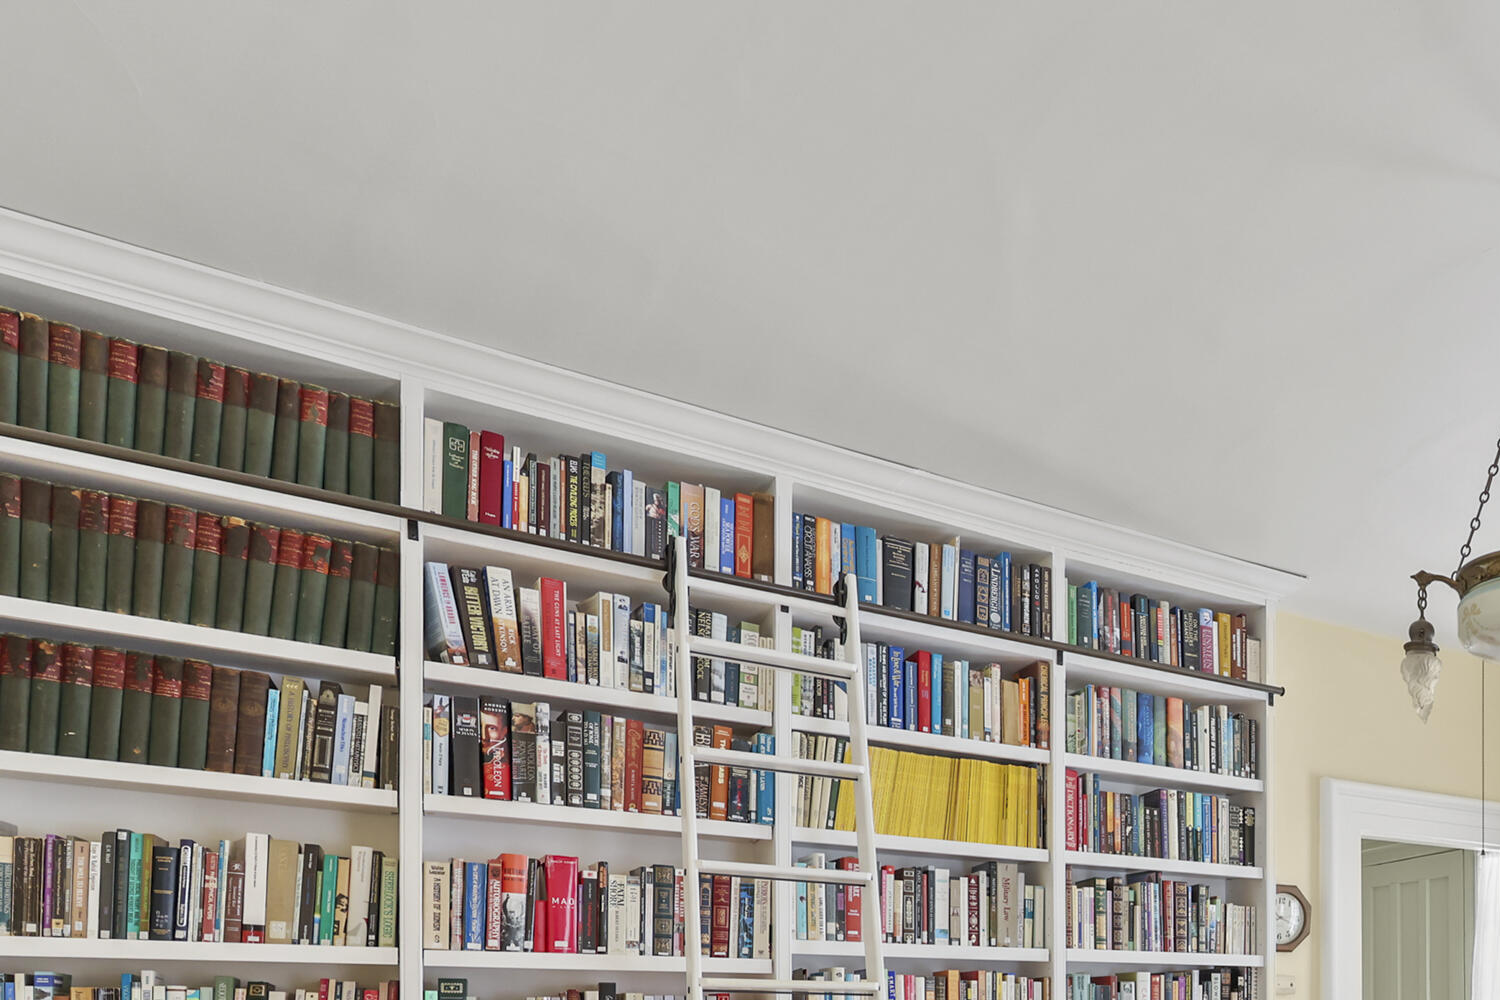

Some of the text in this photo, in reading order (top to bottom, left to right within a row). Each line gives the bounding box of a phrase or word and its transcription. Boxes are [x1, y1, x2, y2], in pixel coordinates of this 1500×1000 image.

[690, 538, 702, 558] WAR
[490, 577, 502, 614] AT DAWN
[502, 579, 514, 616] AN ARMY
[990, 568, 1000, 612] LINDBERGH
[464, 586, 488, 652] BITTER VICTORY
[554, 618, 561, 626] AT
[1182, 621, 1190, 643] GIANTS
[1186, 612, 1194, 646] SHOULDERS
[1191, 618, 1198, 628] ON
[507, 628, 516, 644] RICK
[287, 697, 295, 722] HISTORY
[1040, 666, 1048, 728] CHEMICAL PRINCIPLES
[282, 732, 292, 768] PHILOSOPHY
[488, 738, 506, 788] NAPOLEON
[1066, 789, 1076, 843] DICTIONARY
[432, 883, 440, 903] HISTORY
[551, 896, 574, 904] MAO
[609, 880, 617, 908] SHORE
[616, 884, 624, 908] FATAL
[1002, 878, 1011, 922] Military Law
[432, 912, 440, 932] ZIONISM
[491, 880, 499, 939] AUTOBIOGRAPHY
[384, 918, 395, 938] LOGIC
